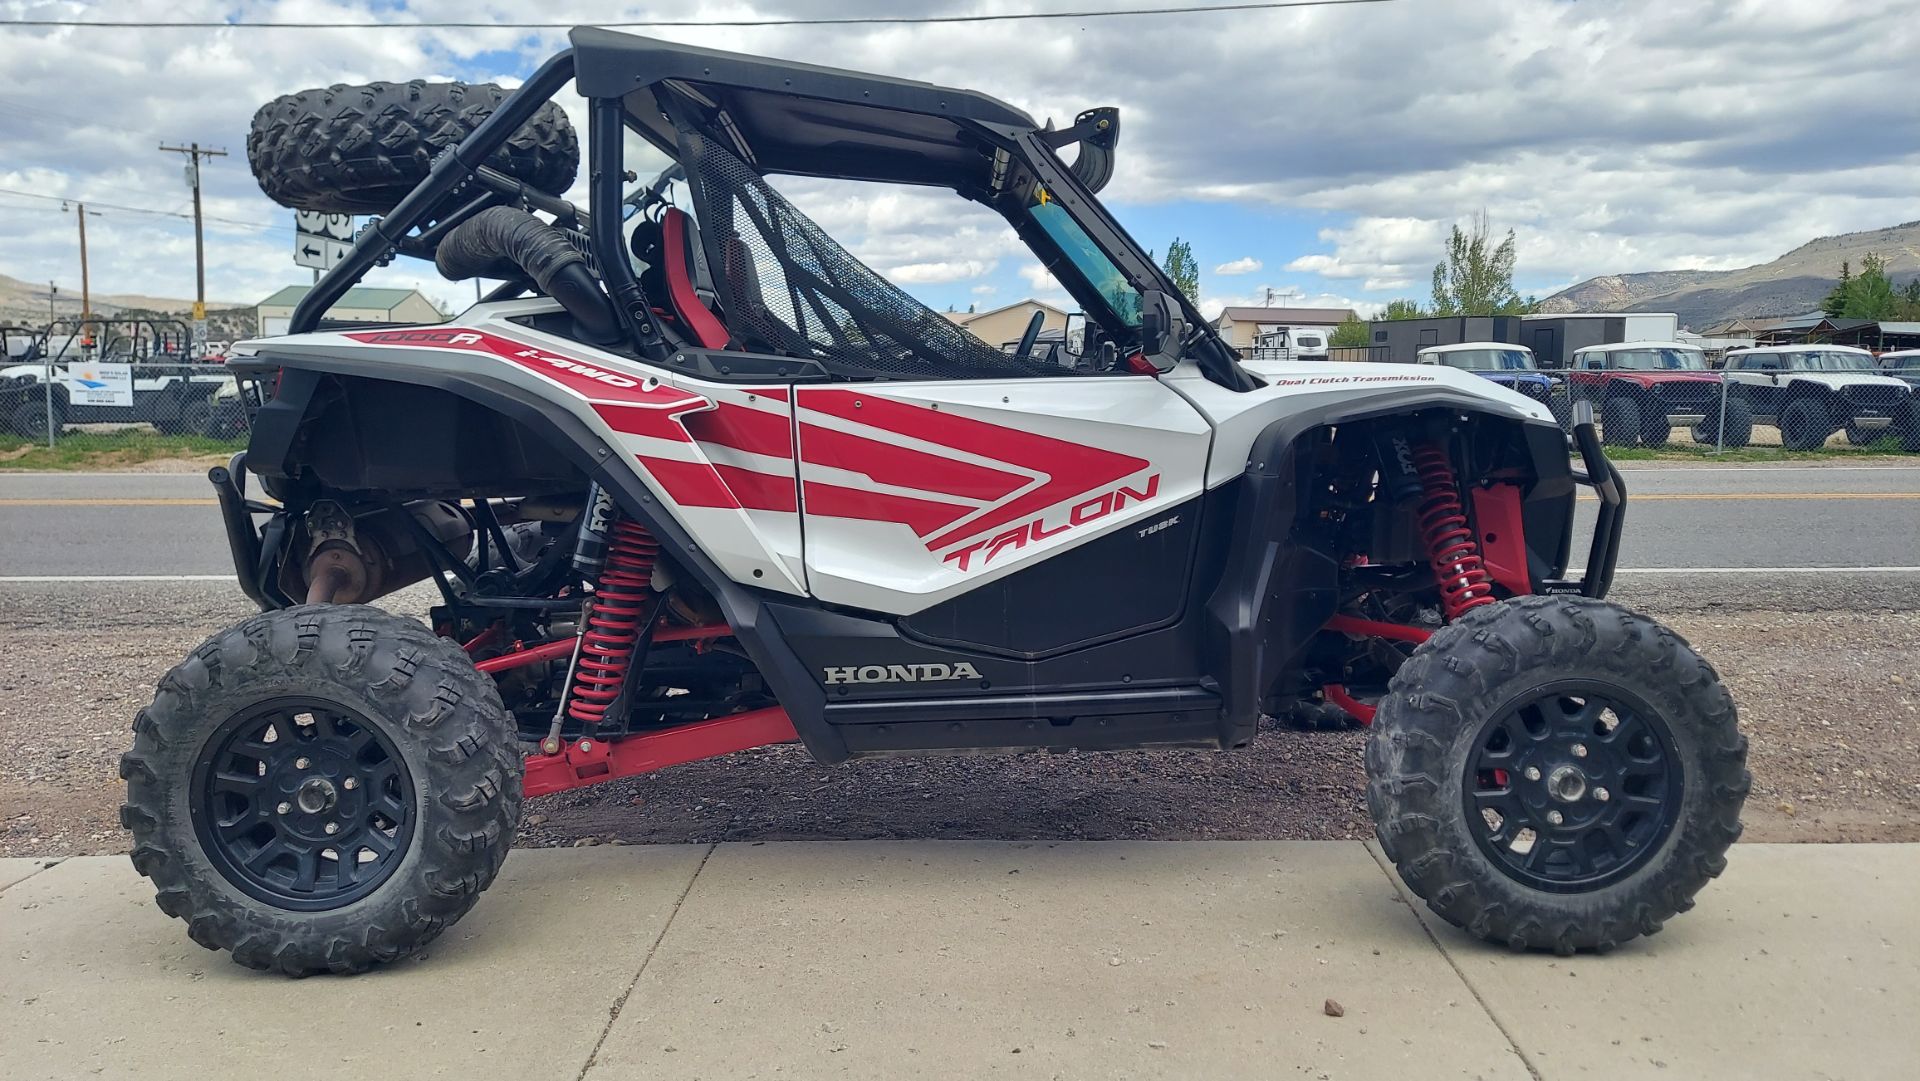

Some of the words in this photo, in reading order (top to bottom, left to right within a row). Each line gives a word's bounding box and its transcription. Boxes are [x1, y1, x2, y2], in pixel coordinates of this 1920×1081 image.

[368, 333, 484, 344] 1000R
[514, 350, 638, 388] i-4WD
[1309, 376, 1349, 385] Clutch
[1352, 374, 1435, 383] Transmission
[1392, 437, 1418, 474] FOX
[590, 486, 616, 533] FOX
[943, 473, 1161, 572] TALON
[1138, 515, 1180, 538] TUSK
[823, 662, 984, 685] HONDA
